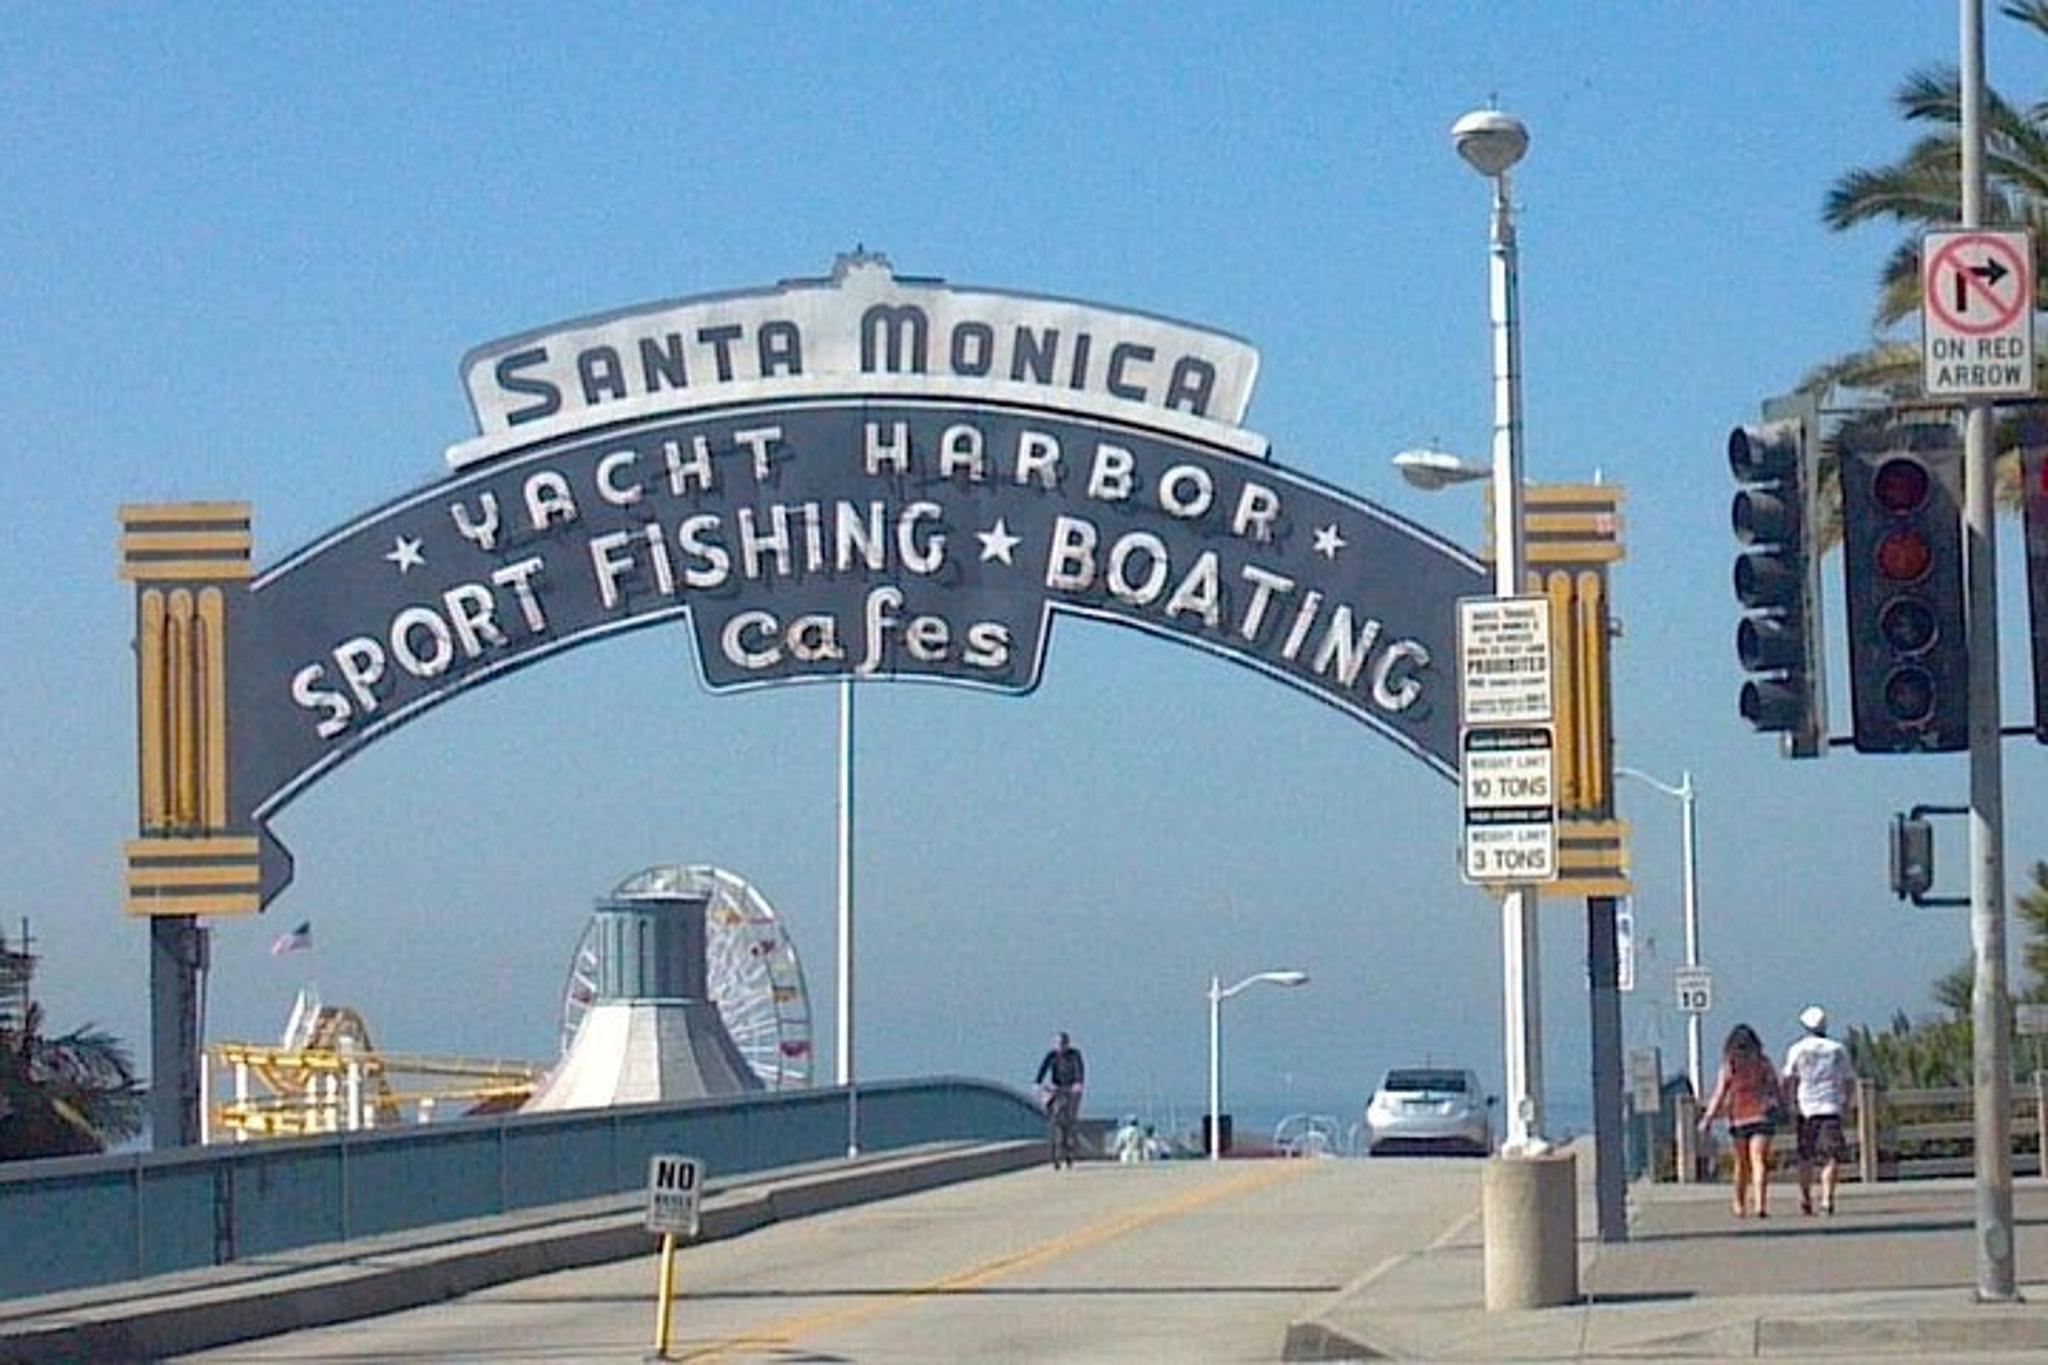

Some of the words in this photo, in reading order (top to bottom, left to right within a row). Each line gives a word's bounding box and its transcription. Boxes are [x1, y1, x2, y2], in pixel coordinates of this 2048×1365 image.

[1933, 338, 1965, 359] ON
[1978, 337, 2024, 359] RED
[495, 320, 803, 428] SANTA
[861, 303, 1216, 416] MONICA
[1937, 363, 2022, 386] ARROW
[451, 426, 782, 550] YACHT
[864, 422, 1280, 543] HARBOR
[291, 556, 546, 739] SPORT
[591, 501, 947, 608] FISHING
[1046, 515, 1430, 712] BOATING
[722, 586, 1010, 675] cafes
[1473, 778, 1491, 798] 10
[1498, 776, 1548, 798] TONS
[1473, 848, 1486, 870] 3
[1494, 847, 1546, 870] TONS
[1683, 991, 1708, 1008] 10
[657, 1161, 695, 1190] NO
